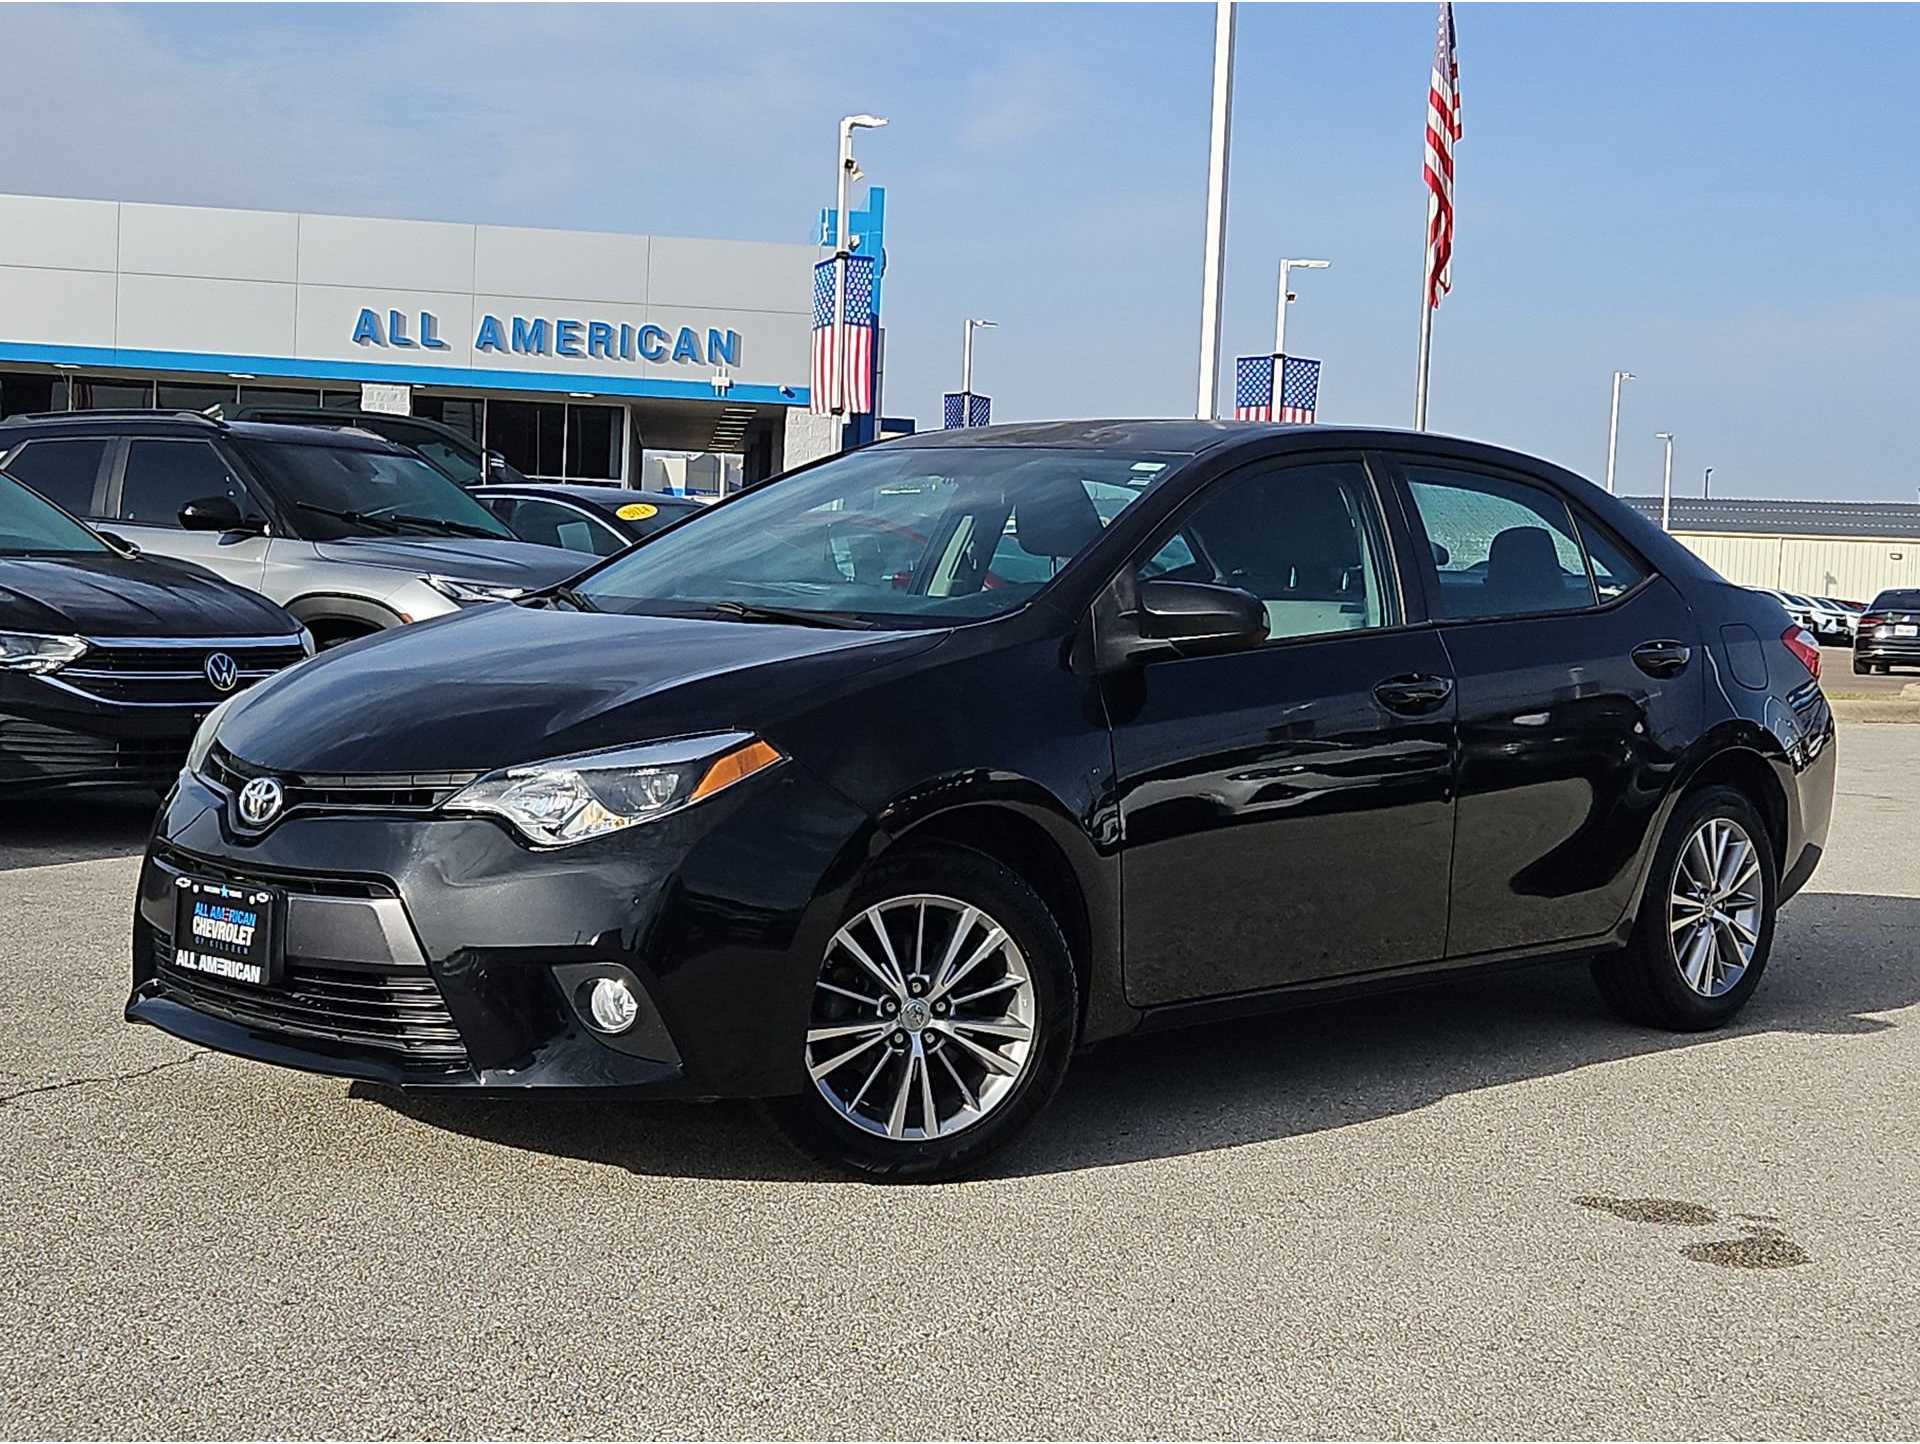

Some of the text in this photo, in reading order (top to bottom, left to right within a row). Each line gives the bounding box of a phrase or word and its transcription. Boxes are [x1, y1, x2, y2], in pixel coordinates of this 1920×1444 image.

[352, 308, 739, 366] ALL AMERICAN
[194, 902, 256, 926] ALL AMERICAN
[192, 916, 256, 946] CHEVROLET
[176, 949, 261, 984] ALL AMERICAN
